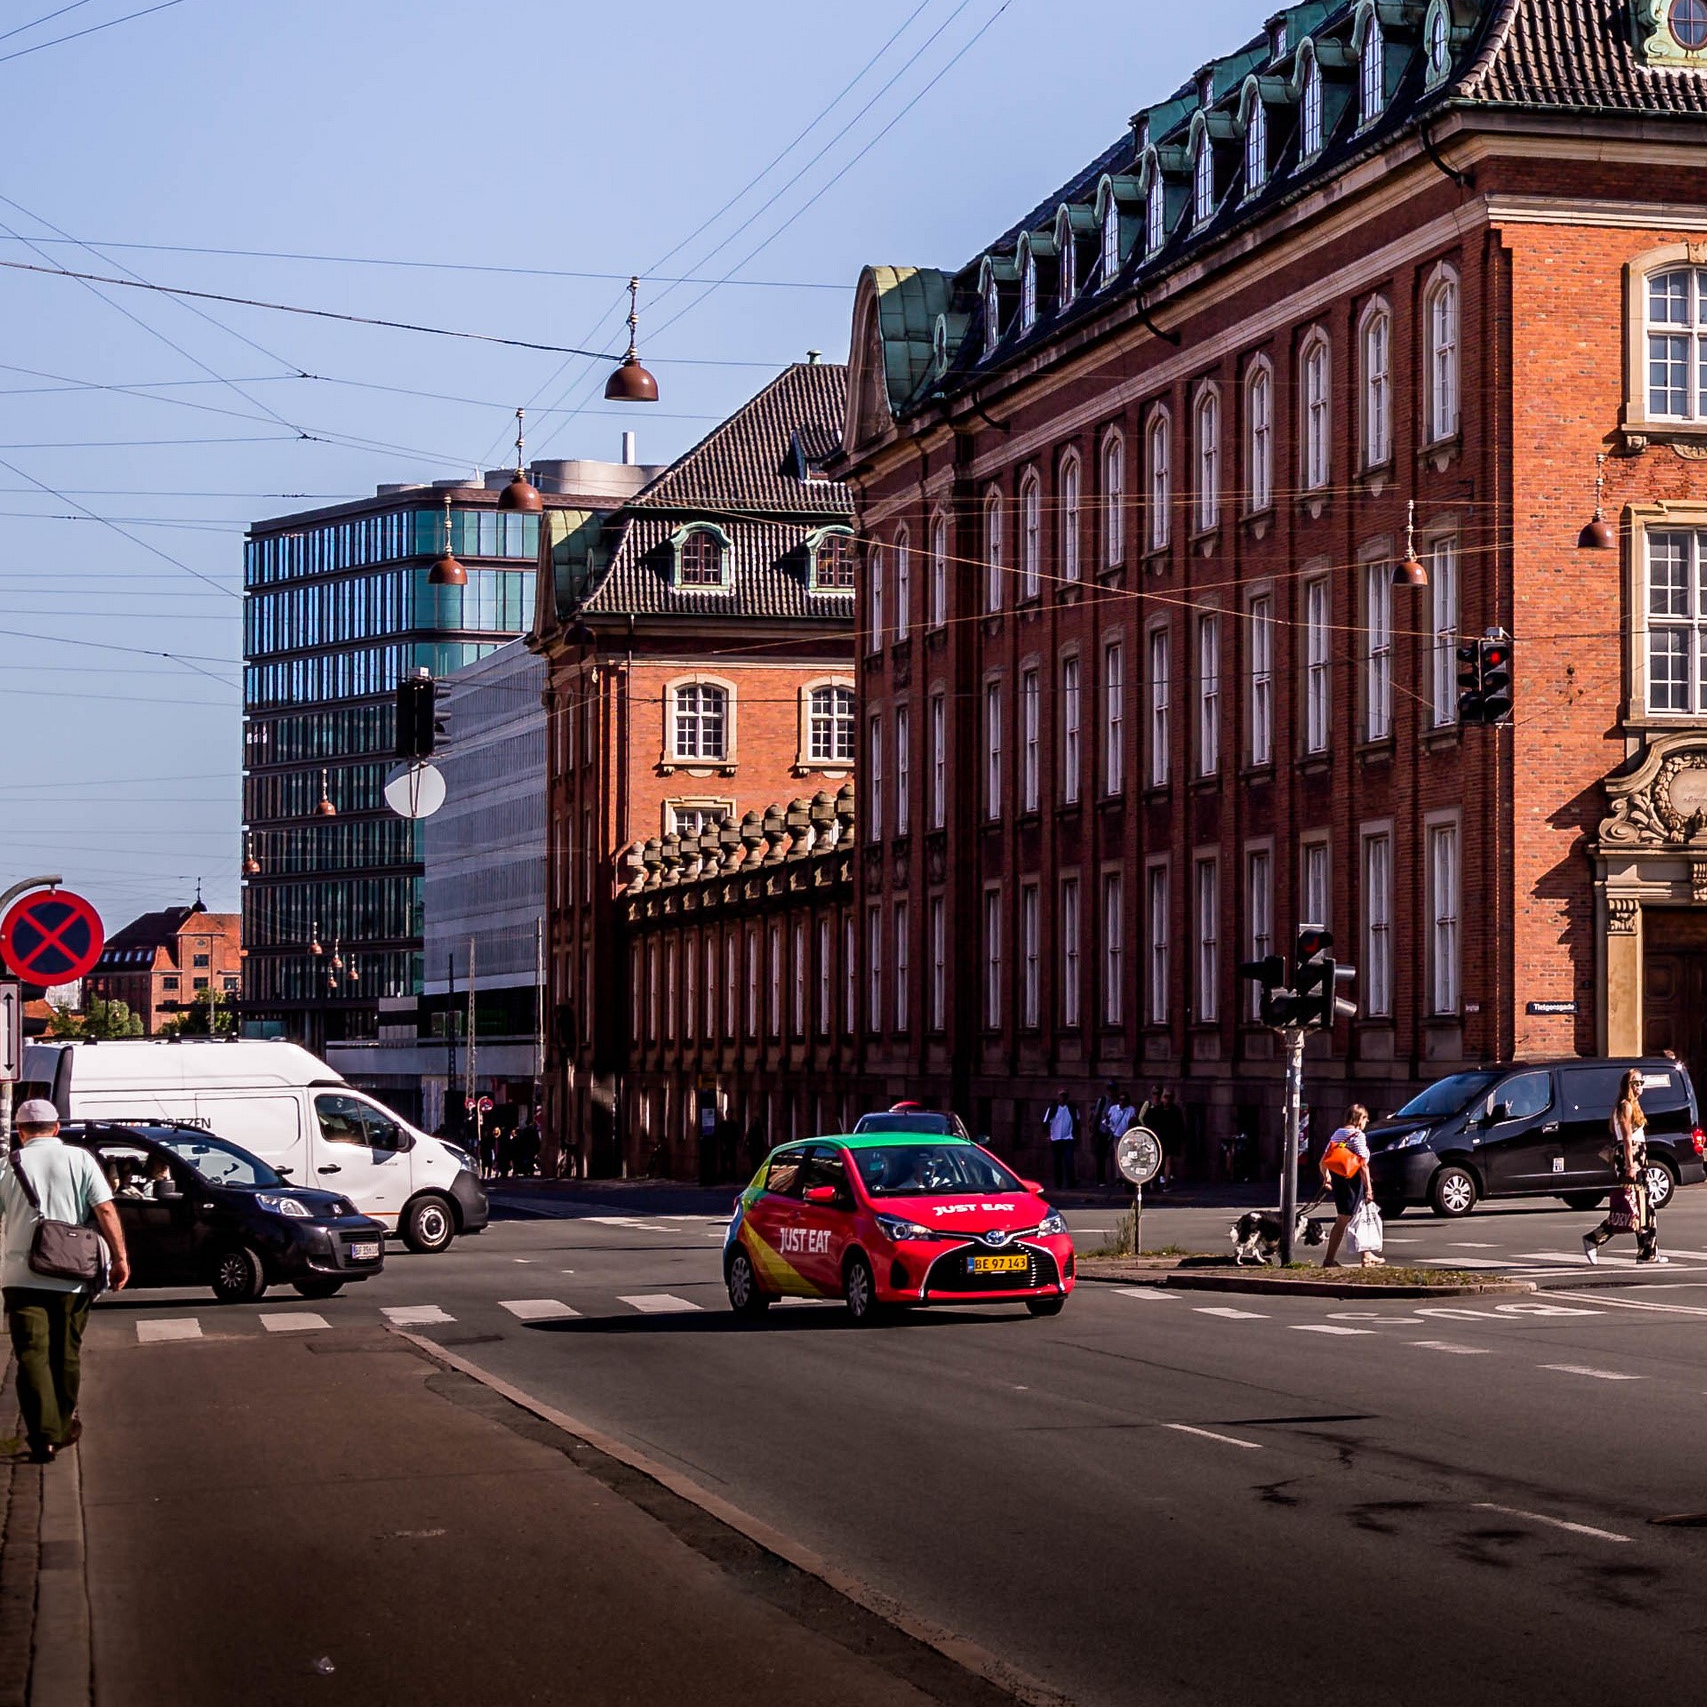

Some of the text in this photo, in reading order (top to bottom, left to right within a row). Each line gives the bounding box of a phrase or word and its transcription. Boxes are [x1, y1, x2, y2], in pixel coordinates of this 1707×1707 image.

[932, 1203, 1015, 1216] JUST EAT
[780, 1227, 832, 1254] JUST EAT
[975, 1257, 1026, 1269] BE 97 143
